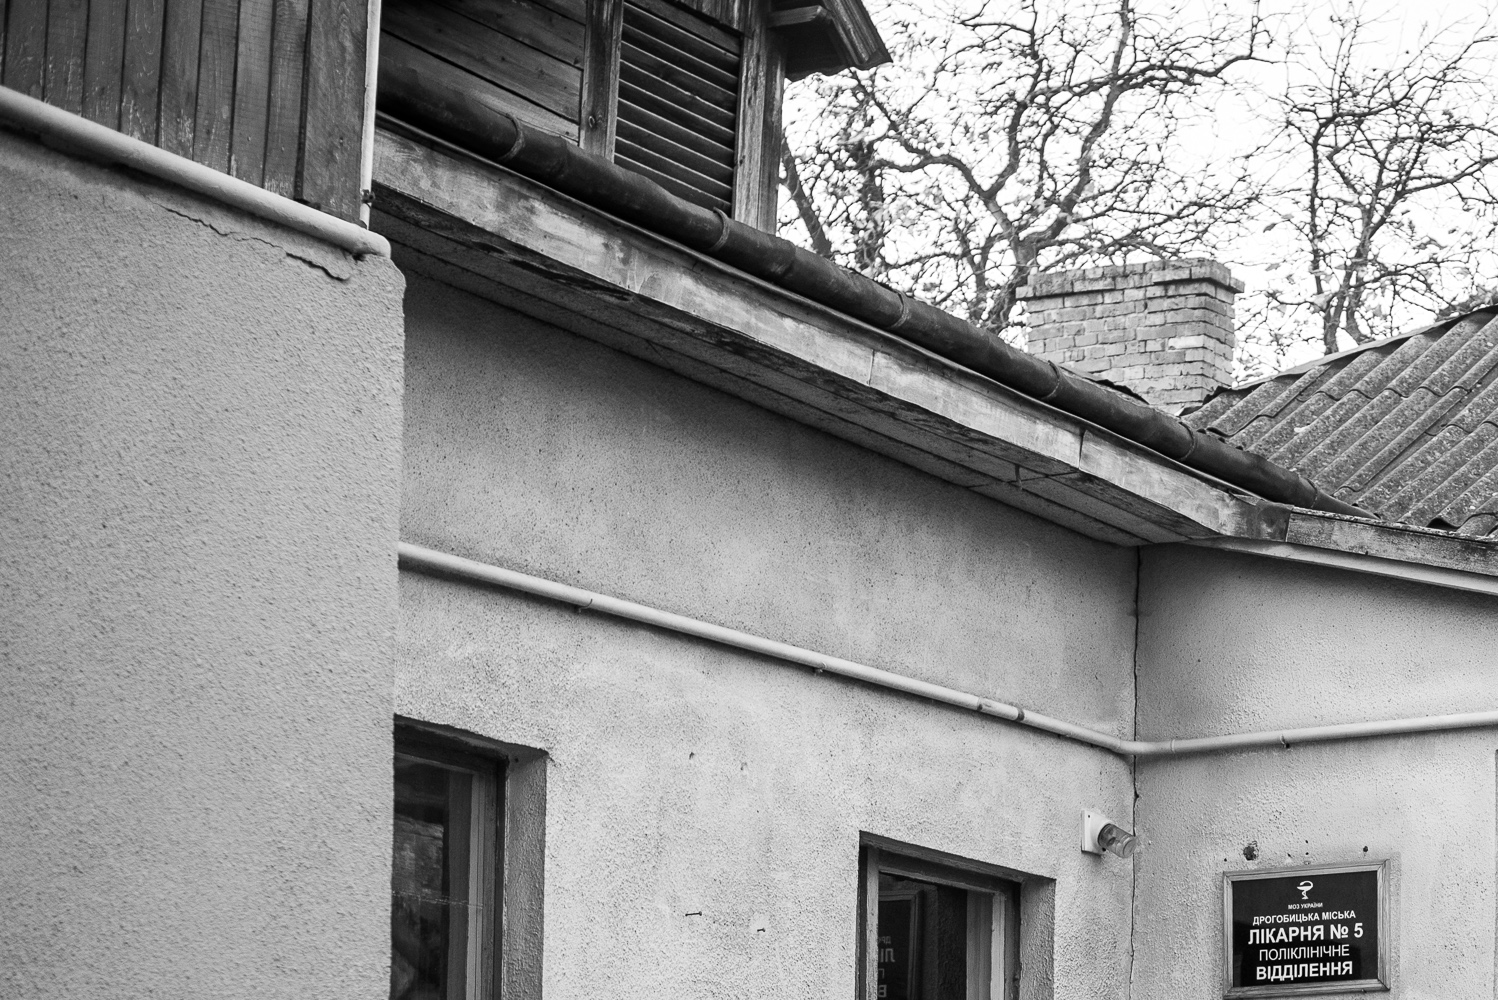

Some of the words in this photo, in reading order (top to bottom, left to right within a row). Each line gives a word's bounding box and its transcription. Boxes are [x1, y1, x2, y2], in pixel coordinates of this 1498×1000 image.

[1253, 913, 1320, 926] ДРОГОБИЦЬКА
[1322, 910, 1356, 920] МІСЬКА
[1248, 925, 1325, 945] ЛІКАРНЯ
[1330, 923, 1349, 940] №
[1354, 922, 1364, 938] 5
[1259, 944, 1350, 961] ПОЛІКЛІНІЧНЕ
[1256, 961, 1353, 982] ВІДДІЛЕННЯ
